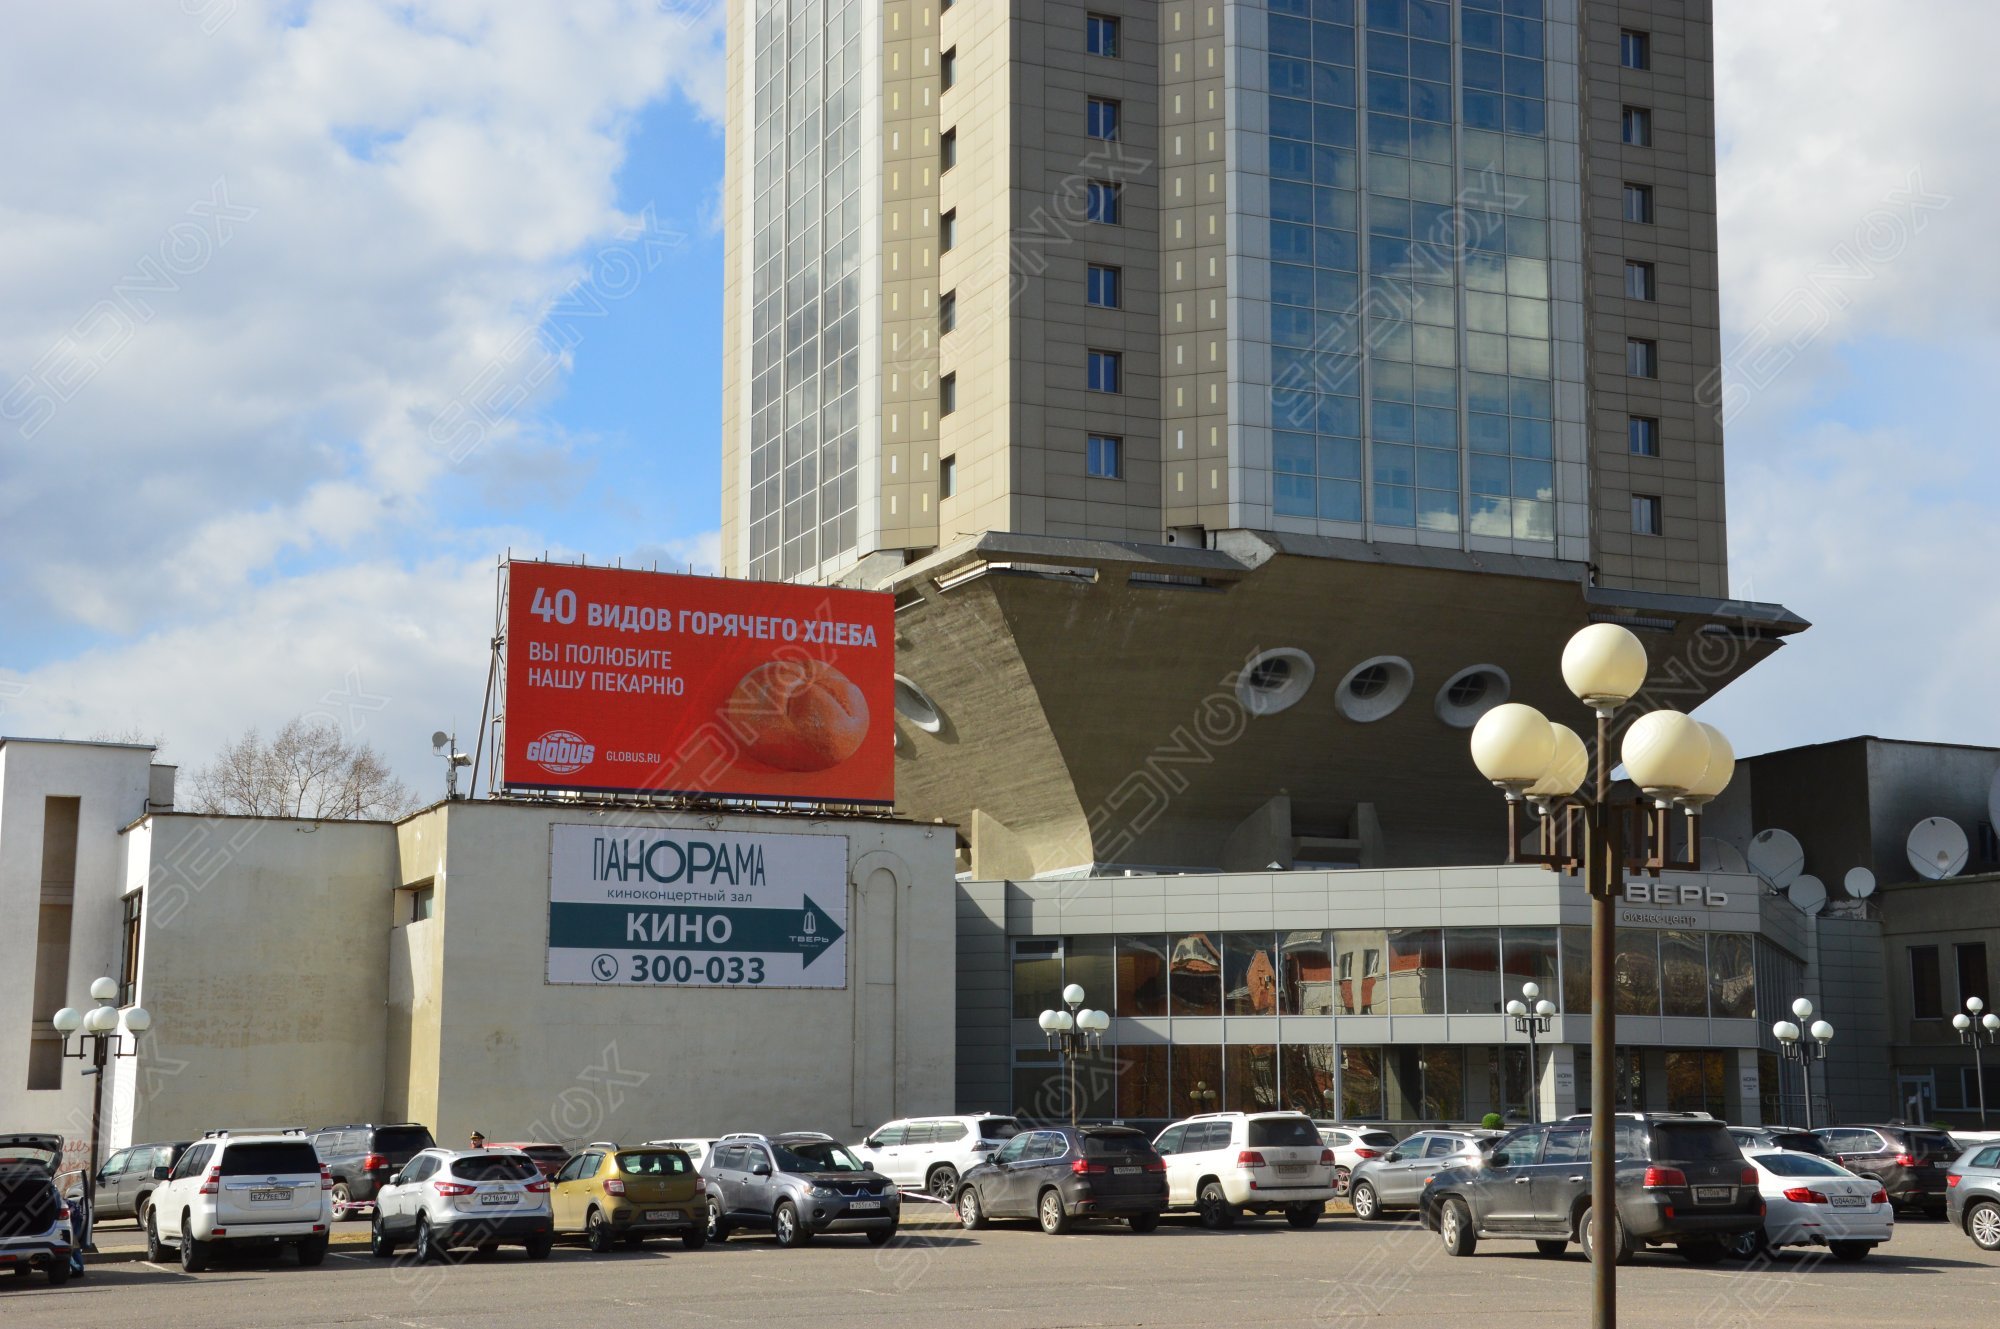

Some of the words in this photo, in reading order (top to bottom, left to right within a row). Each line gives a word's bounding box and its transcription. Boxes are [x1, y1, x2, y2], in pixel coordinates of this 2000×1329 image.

[530, 587, 577, 625] 40
[588, 604, 672, 633] ВИДОВ
[679, 611, 797, 641] ГОРЯЧЕГО
[804, 621, 877, 648] ХЛЕБА
[529, 642, 559, 662] ВЫ
[565, 644, 672, 670] ПОЛЮБИТЕ
[528, 668, 586, 690] НАШУ
[592, 673, 684, 696] ПЕКАРНЮ
[606, 751, 660, 764] GLOBUS.RU
[593, 837, 766, 886] ПАНОРАМА
[607, 889, 726, 904] киноконцертный
[731, 892, 753, 902] зал
[1624, 882, 1729, 907] ВЕРЬ
[626, 913, 733, 943] КИНО
[788, 935, 830, 943] ТВЕРЬ
[630, 955, 766, 984] 300-033
